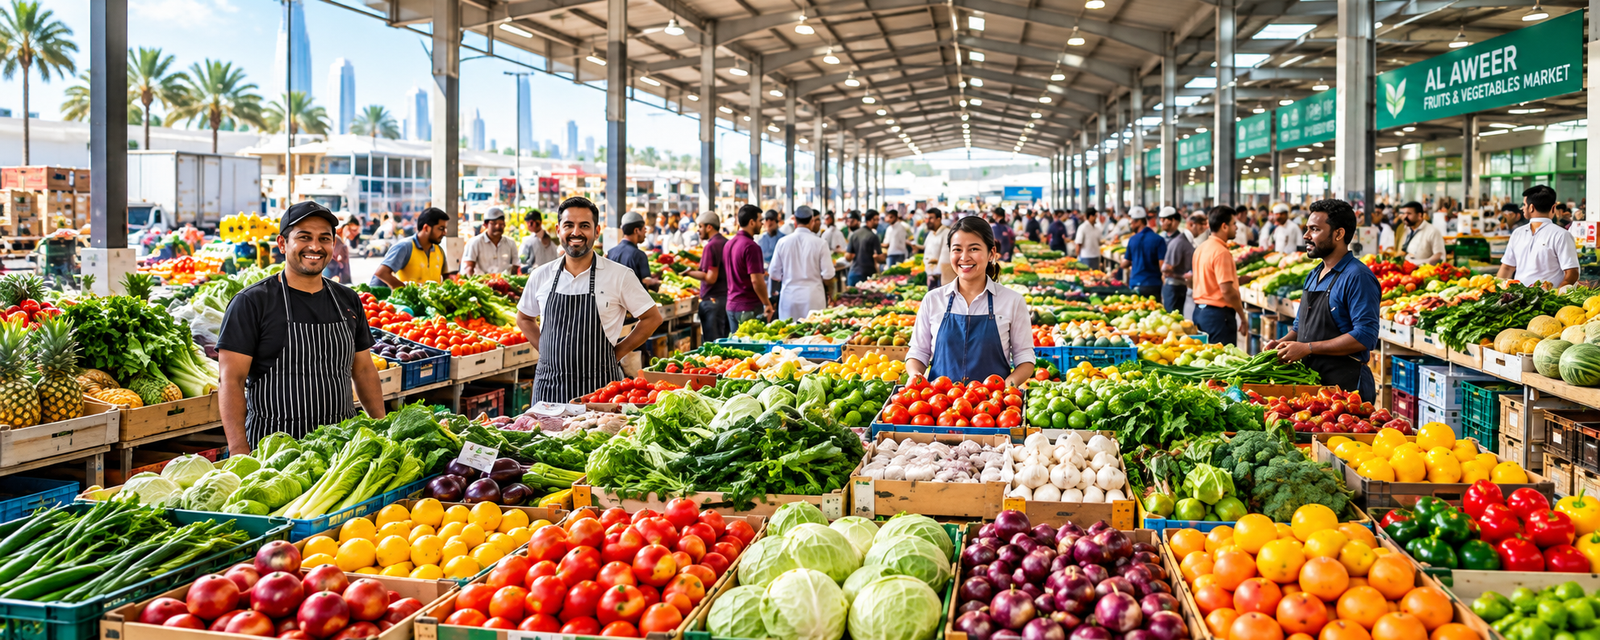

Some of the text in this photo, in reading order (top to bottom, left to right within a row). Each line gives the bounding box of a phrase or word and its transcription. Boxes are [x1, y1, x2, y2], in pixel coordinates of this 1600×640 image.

[1424, 64, 1571, 110] FRUITS & VEGETABLES MARKET
[1425, 45, 1517, 93] AL AWEER
